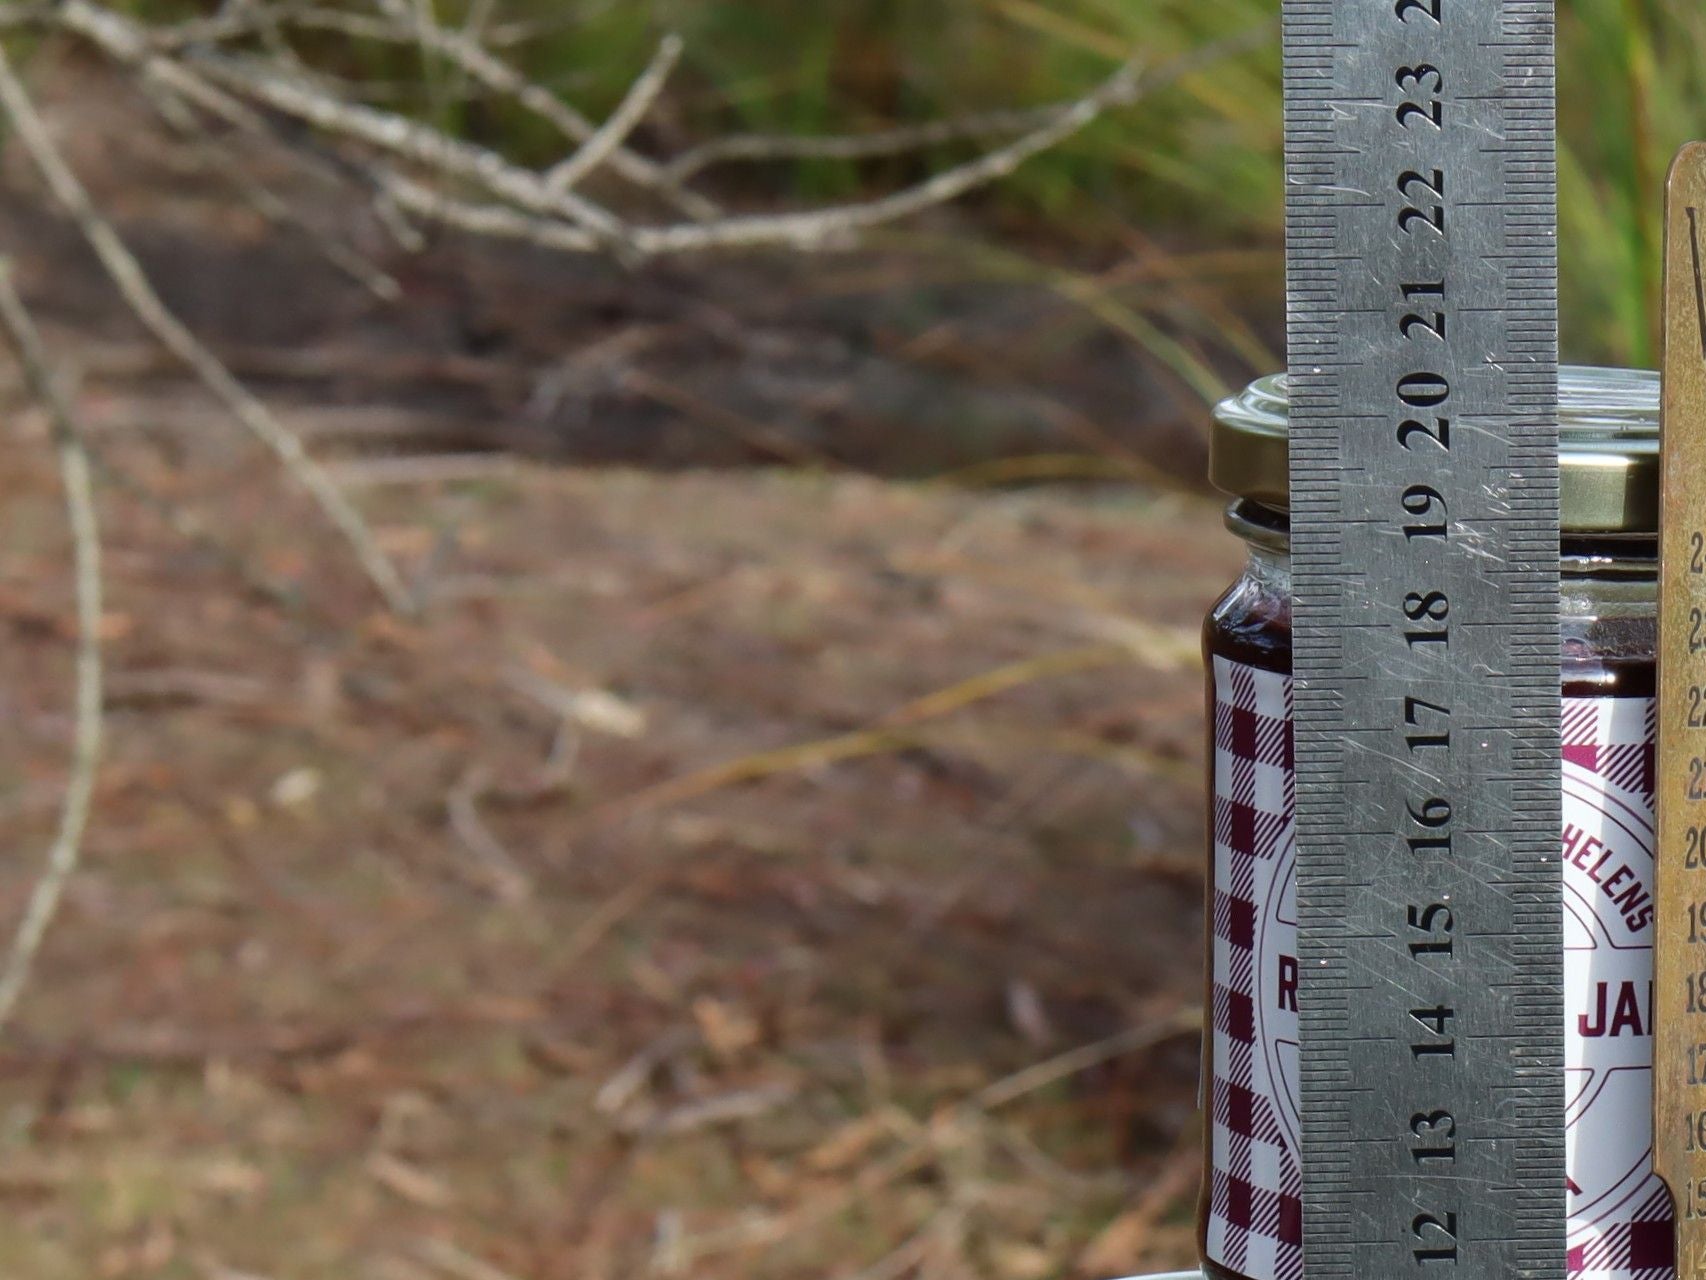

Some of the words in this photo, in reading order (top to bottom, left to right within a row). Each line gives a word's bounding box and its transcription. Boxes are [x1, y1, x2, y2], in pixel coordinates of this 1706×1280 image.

[1396, 63, 1442, 131] 23
[1397, 168, 1443, 236] 22
[1399, 277, 1446, 343] 21
[1396, 371, 1449, 452] 20
[1402, 484, 1448, 543] 19
[1402, 590, 1449, 651] 18
[1405, 695, 1451, 754] 17
[1406, 796, 1453, 857] 16
[1562, 823, 1653, 933] HELENS
[1407, 902, 1453, 961] 15
[1409, 1004, 1454, 1064] 14
[1578, 981, 1653, 1037] JA
[1409, 1108, 1456, 1166] 13
[1412, 1209, 1459, 1267] 12
